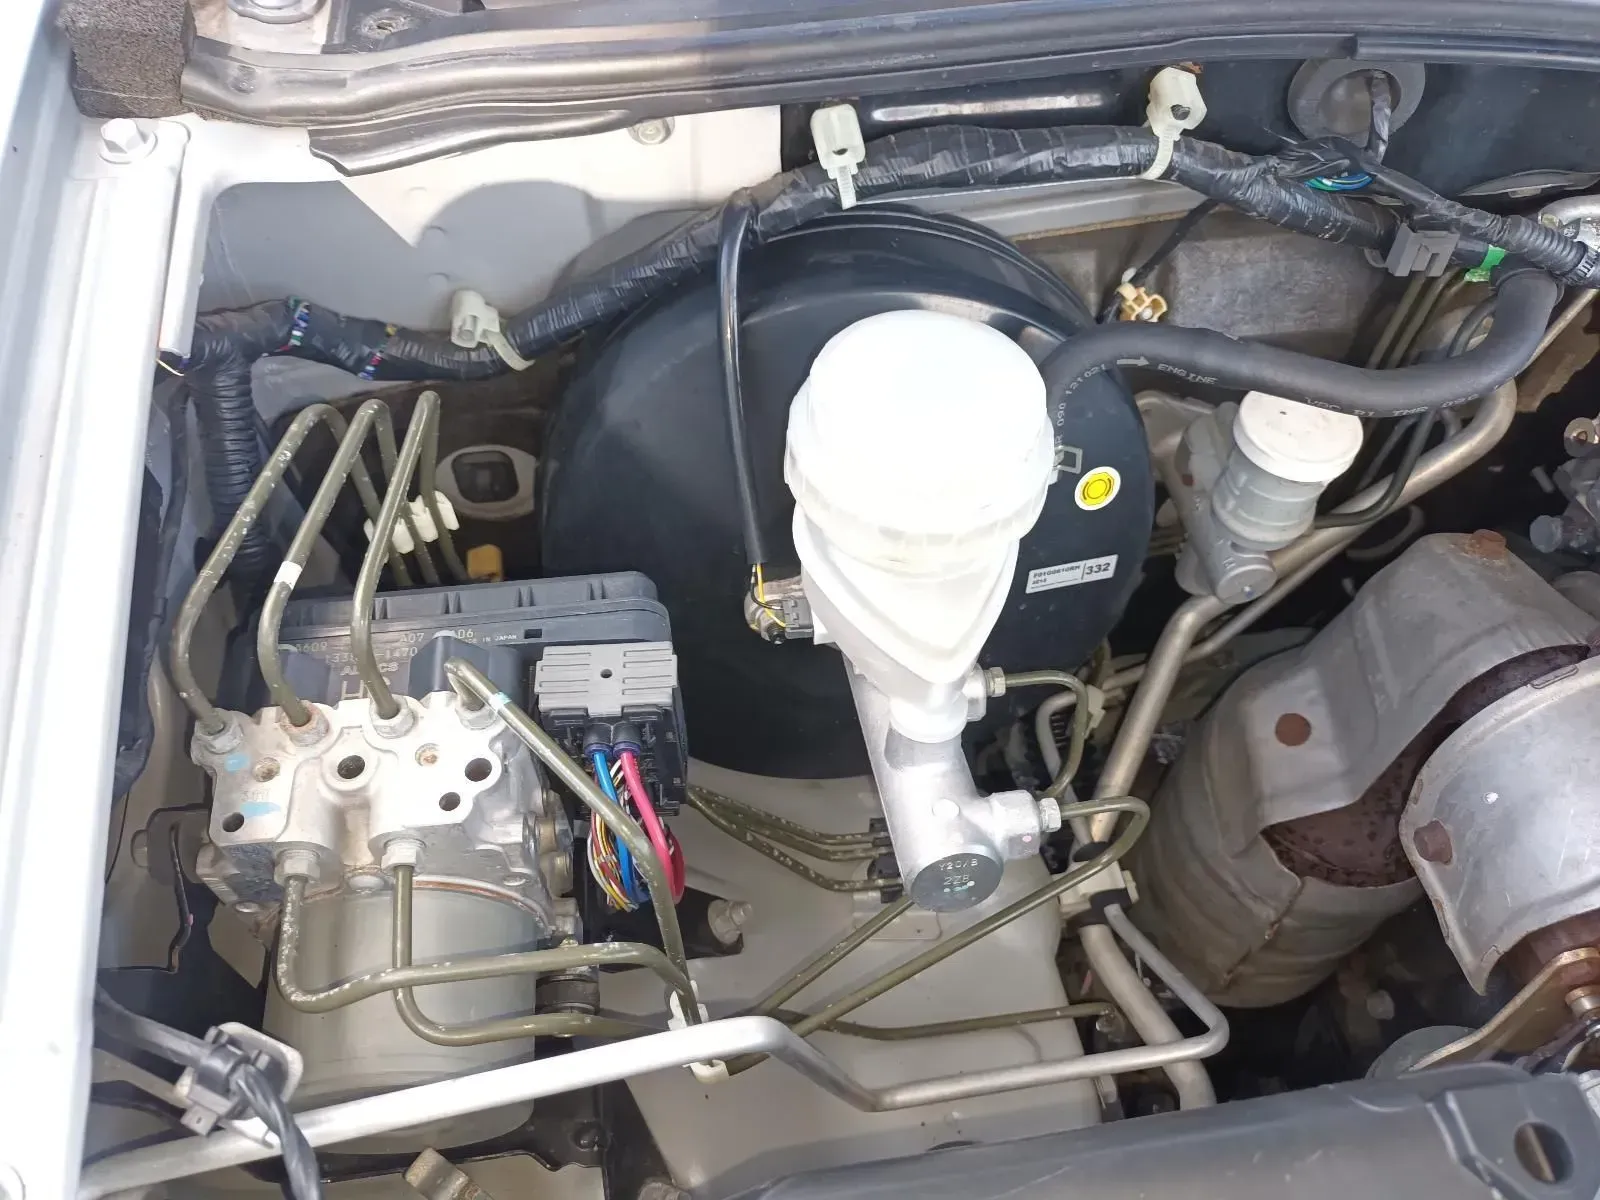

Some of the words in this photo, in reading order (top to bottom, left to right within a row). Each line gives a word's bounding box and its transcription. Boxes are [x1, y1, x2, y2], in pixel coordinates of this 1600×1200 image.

[1157, 363, 1218, 385] ENGINE
[1085, 562, 1111, 576] 332
[401, 632, 425, 644] A07
[495, 633, 518, 642] JAPAN
